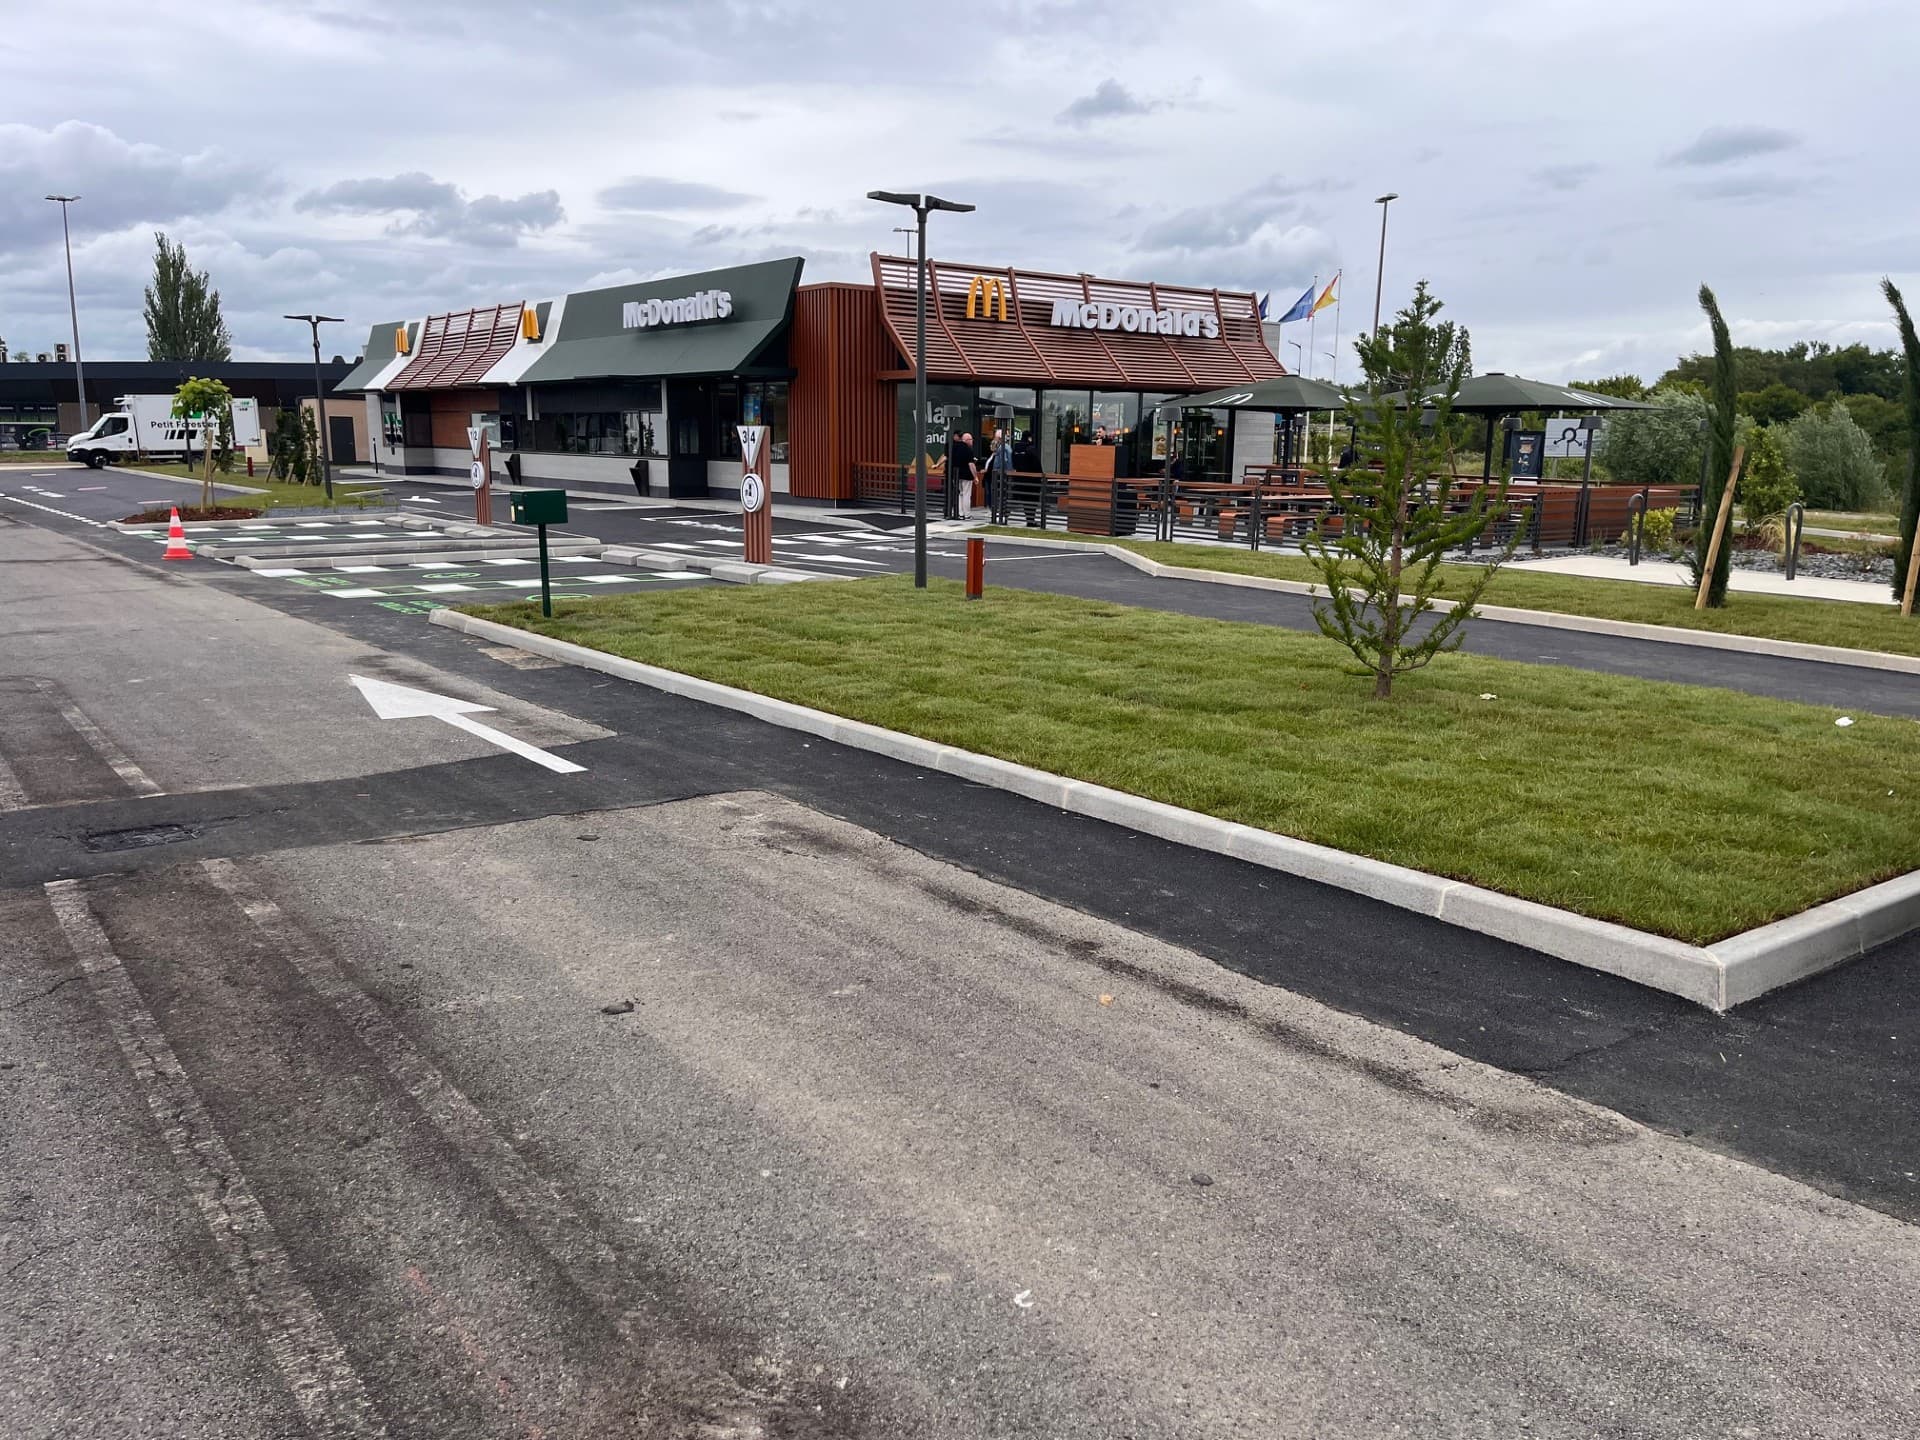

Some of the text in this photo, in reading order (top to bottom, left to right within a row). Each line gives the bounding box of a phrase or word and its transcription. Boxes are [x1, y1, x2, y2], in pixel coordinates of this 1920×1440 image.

[623, 290, 732, 329] McDonald's
[1050, 299, 1219, 339] McDonald's
[150, 420, 174, 429] Petit
[750, 430, 756, 444] 4
[926, 432, 947, 444] and
